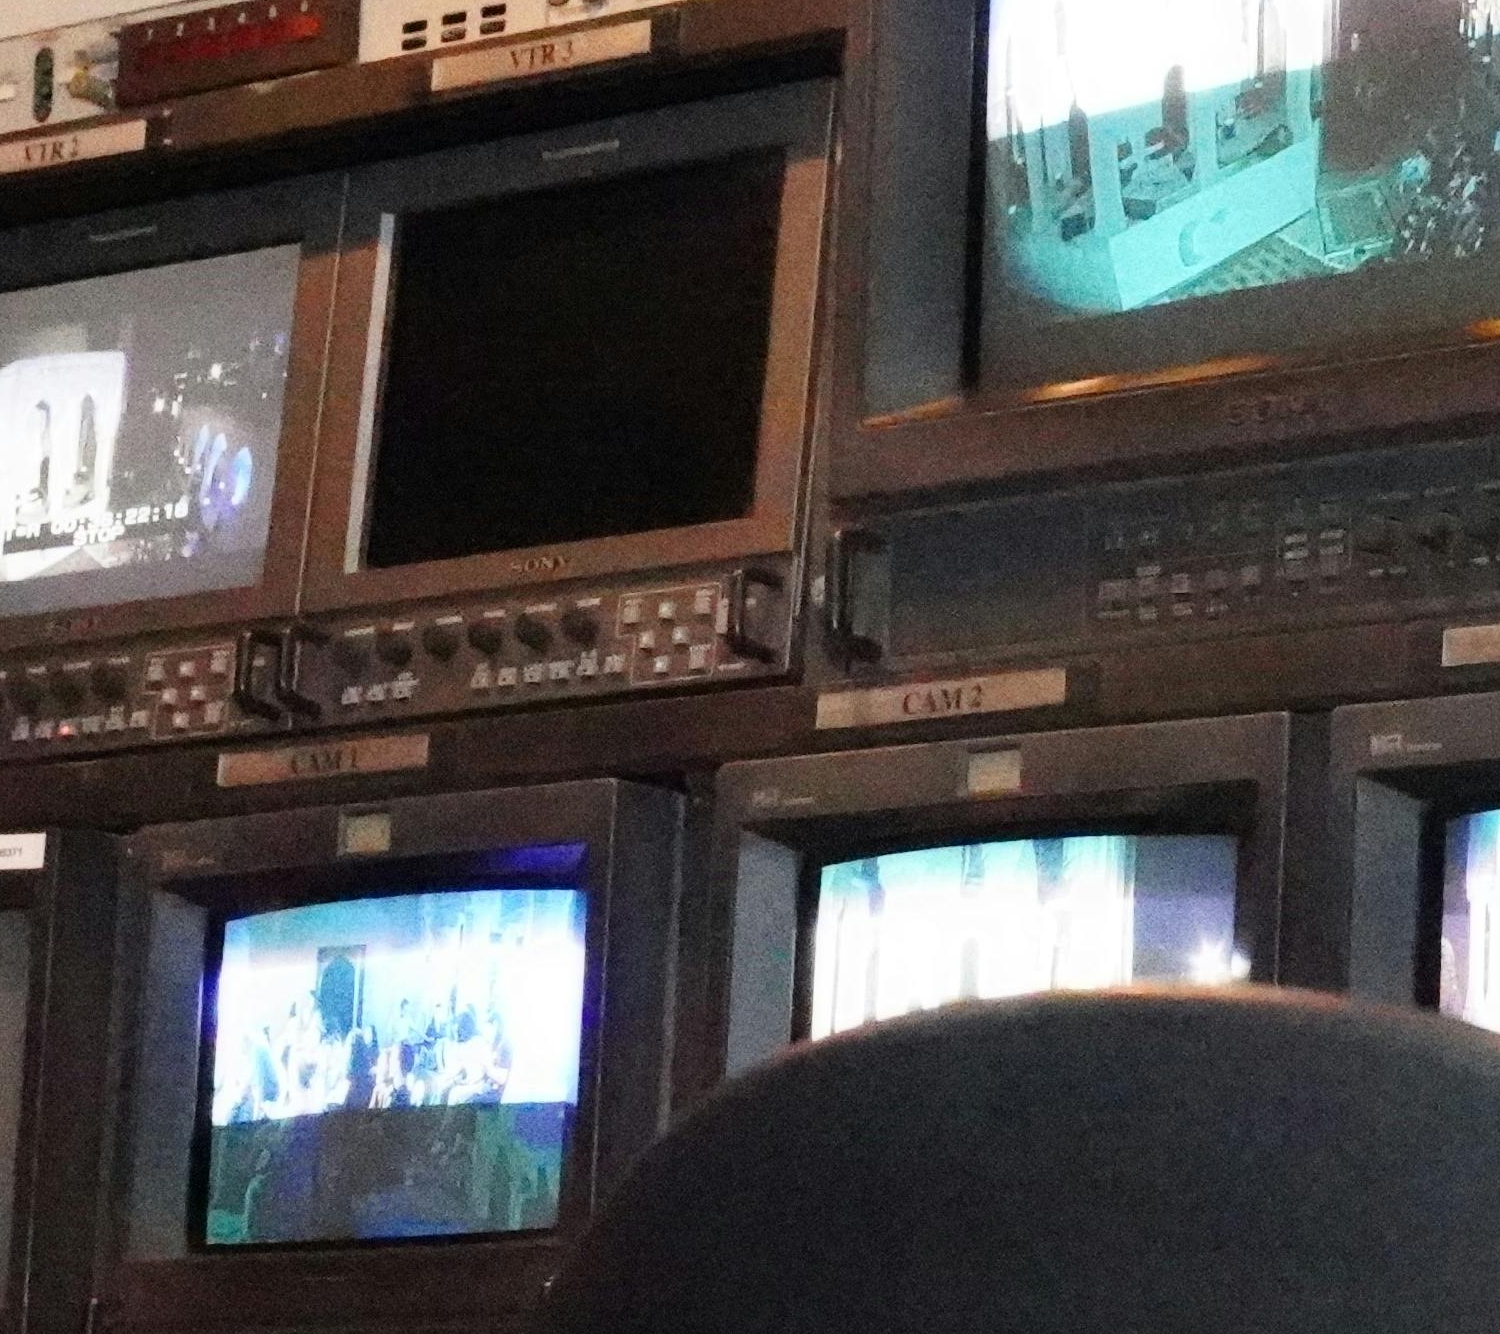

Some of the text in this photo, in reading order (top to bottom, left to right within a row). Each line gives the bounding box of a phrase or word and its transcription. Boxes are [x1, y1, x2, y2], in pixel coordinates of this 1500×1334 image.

[510, 43, 556, 70] VTR
[25, 140, 65, 163] VTR
[72, 523, 126, 546] STOP
[510, 555, 568, 576] SONY
[903, 683, 983, 715] CAM 2
[289, 749, 342, 774] CAM
